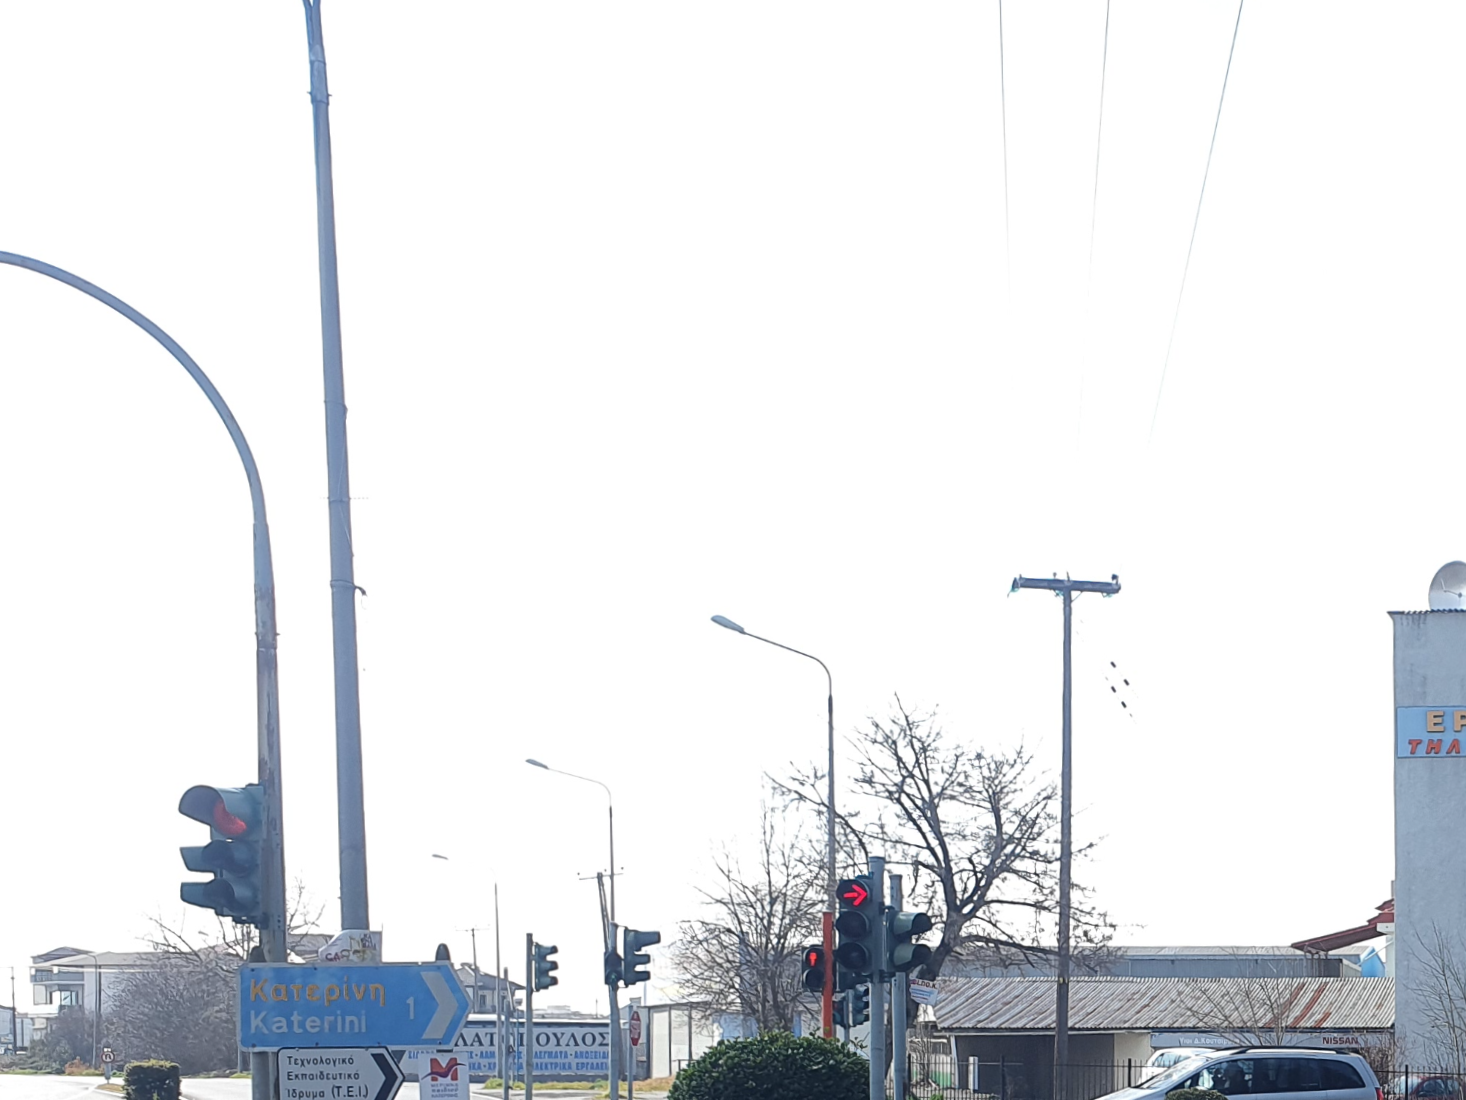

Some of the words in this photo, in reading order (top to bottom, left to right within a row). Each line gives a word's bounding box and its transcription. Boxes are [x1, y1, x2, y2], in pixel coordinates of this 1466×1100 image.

[250, 975, 386, 1007] Κατερίνη
[406, 996, 415, 1020] 1
[250, 1010, 366, 1034] Katerini
[1322, 1036, 1359, 1045] NISSAN
[533, 1051, 569, 1060] ΛΕΓΜΑΤΑ
[574, 1050, 609, 1060] ΑΝΟΞΕΙΔ
[286, 1055, 355, 1068] Τεχνολογικό
[533, 1062, 572, 1071] ΛΕΚΤΡΙΚΑ
[576, 1062, 609, 1071] ΕΡΓΑΛΕΙ
[286, 1071, 360, 1081] Εκπαιδευτικό
